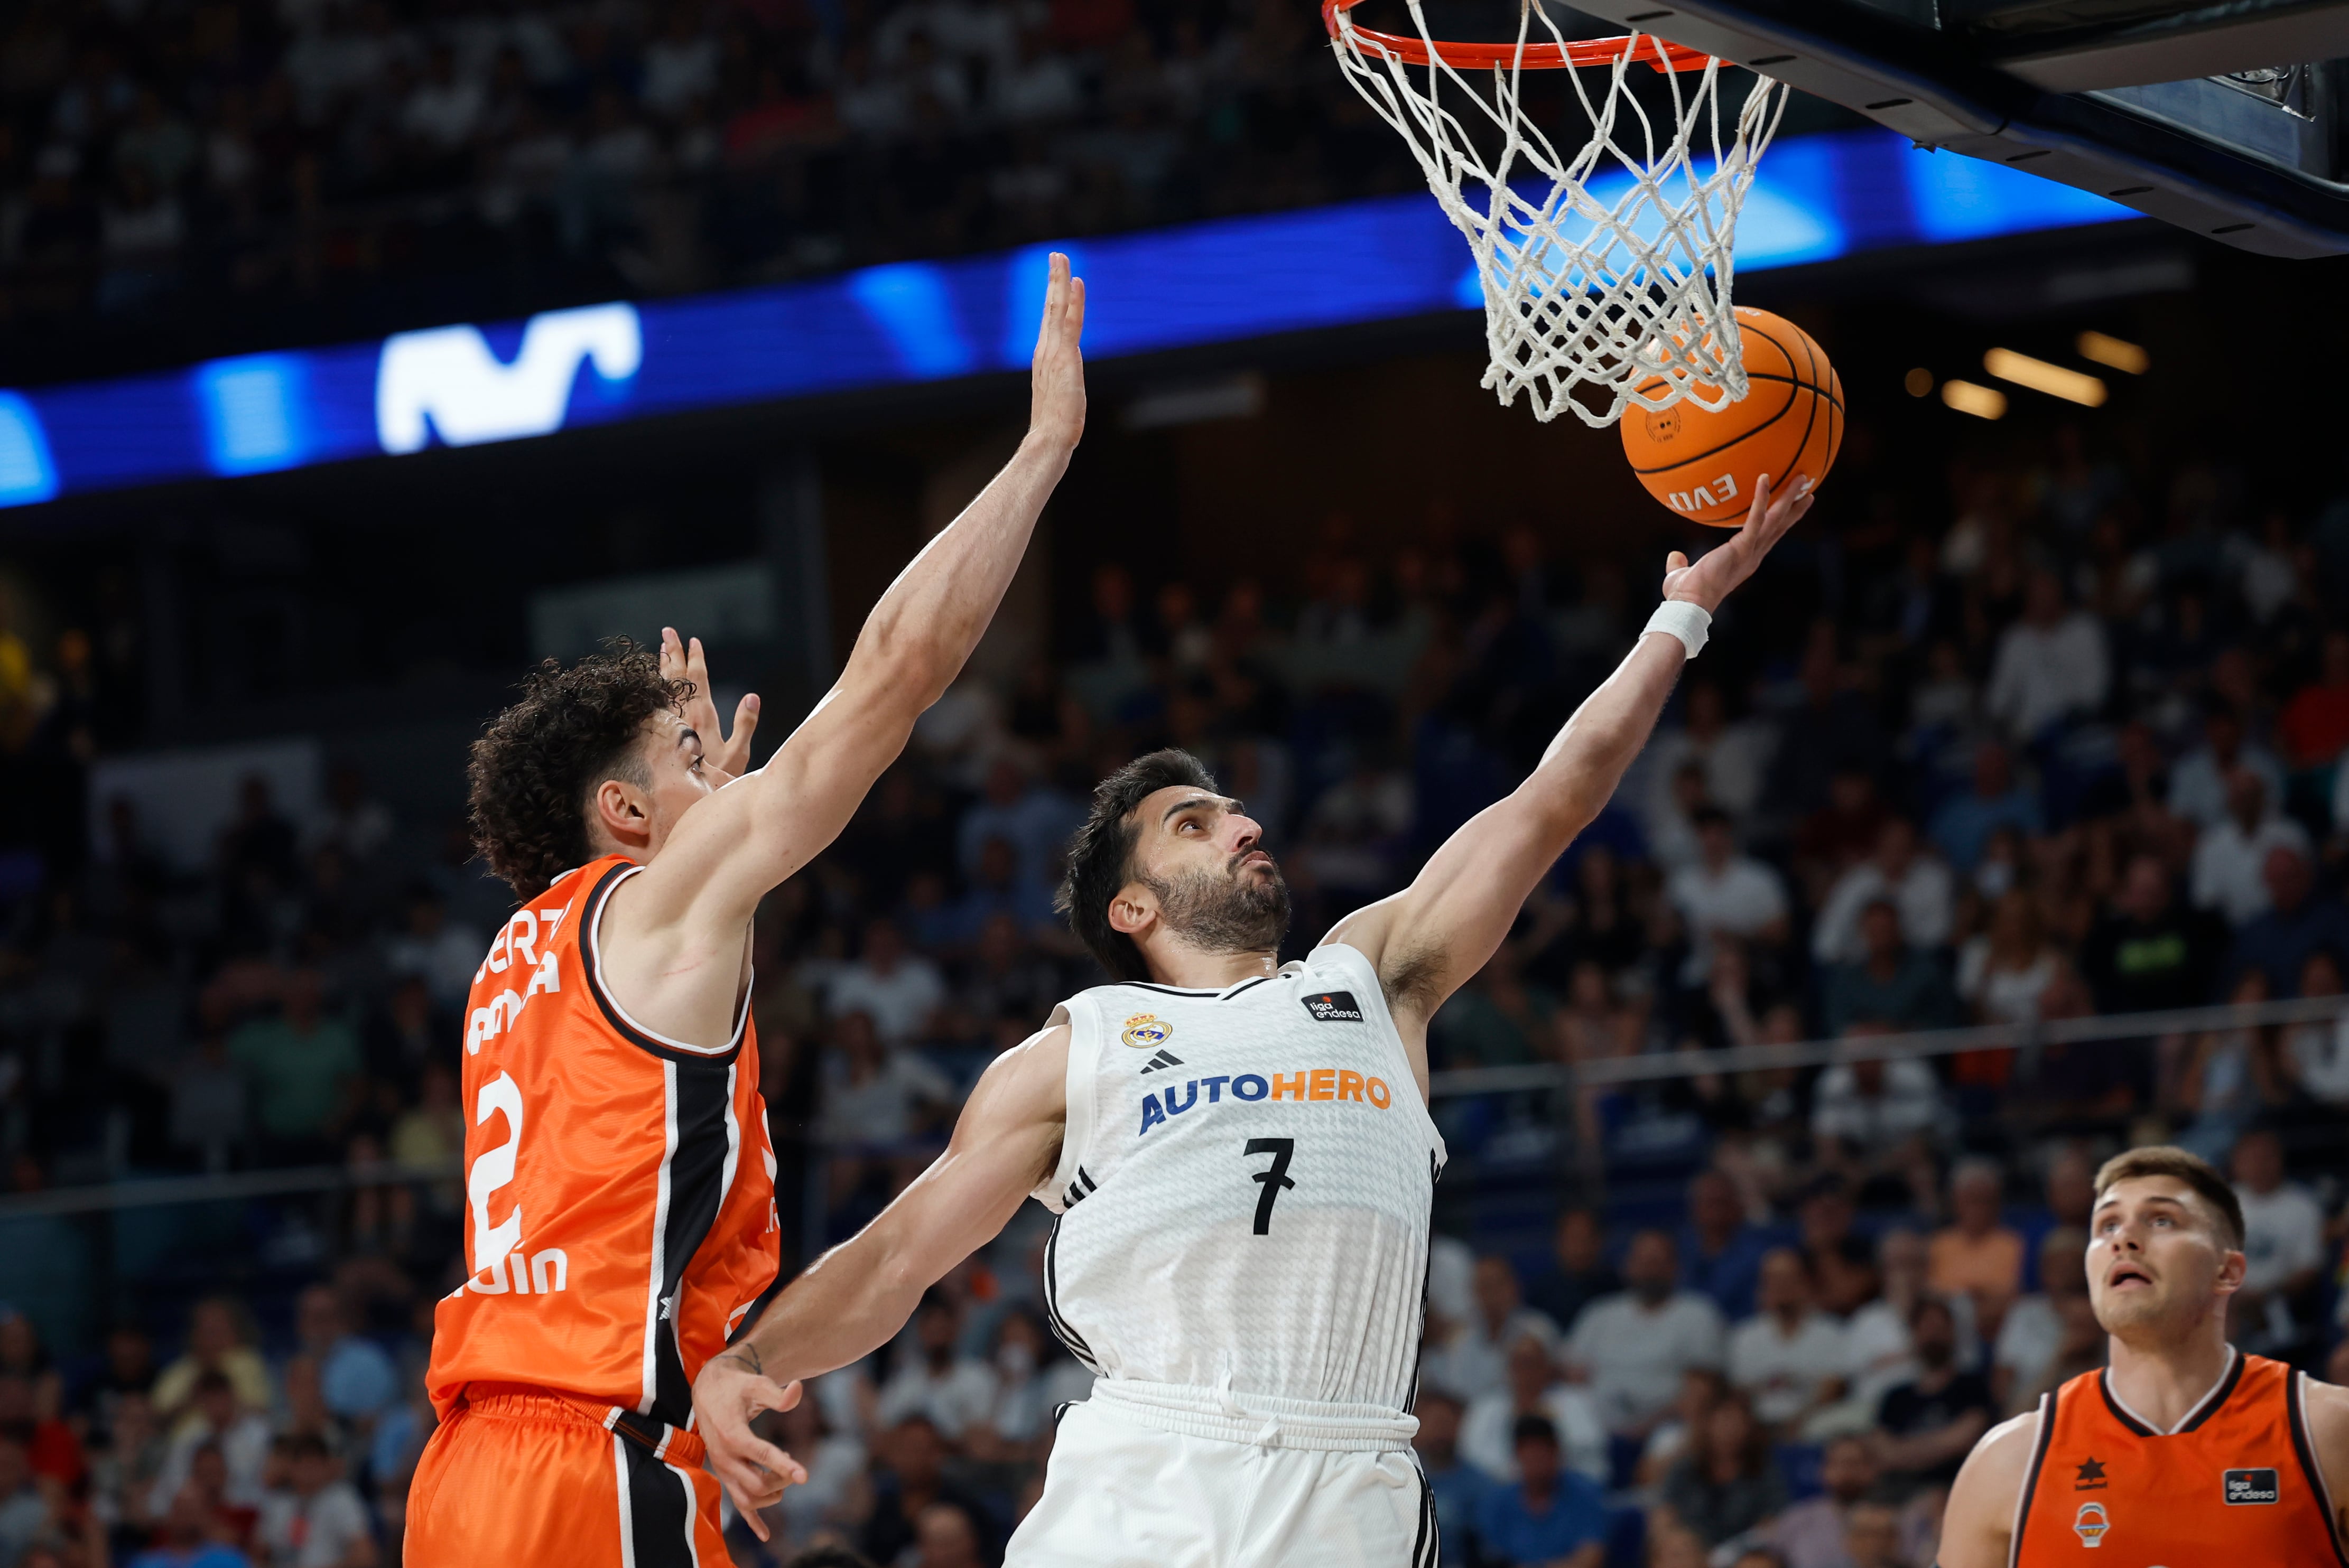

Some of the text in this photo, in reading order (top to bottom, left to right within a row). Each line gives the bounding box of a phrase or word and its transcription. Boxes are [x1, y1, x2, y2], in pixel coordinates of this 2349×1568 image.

[1668, 472, 1738, 512] EVO
[1310, 1002, 1333, 1012] liga
[1316, 1009, 1361, 1019] endesa
[1139, 1069, 1391, 1137] AUTOHERO
[468, 1069, 523, 1273] 2
[1242, 1138, 1296, 1235] 7
[2229, 1489, 2275, 1500] endesa
